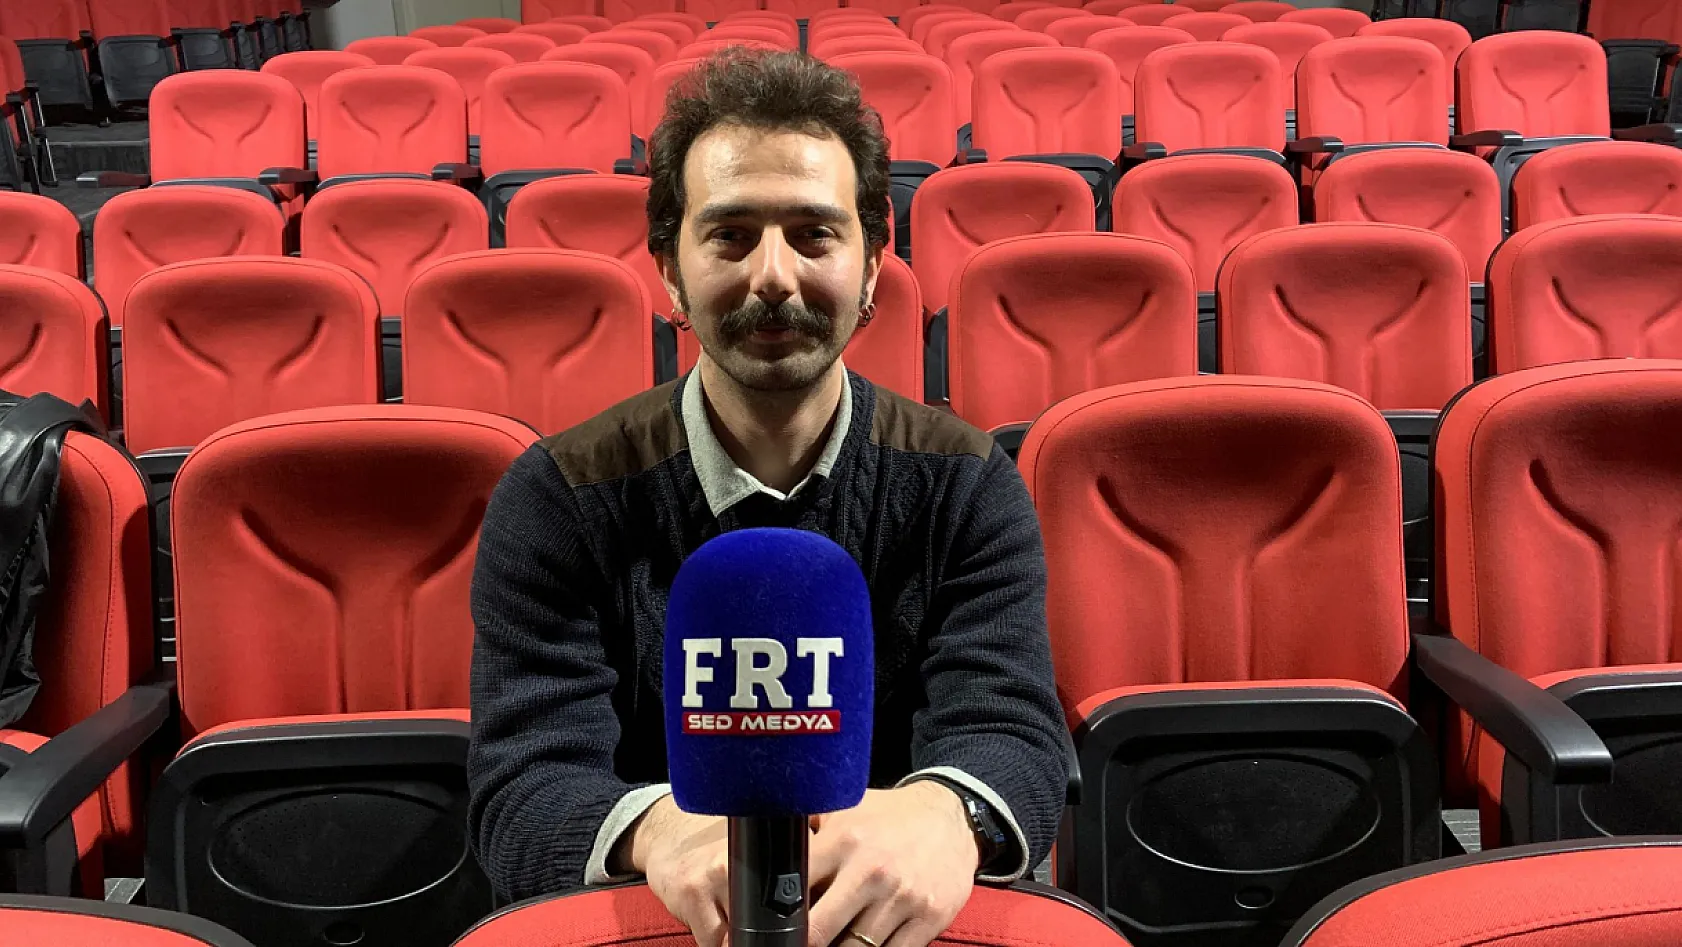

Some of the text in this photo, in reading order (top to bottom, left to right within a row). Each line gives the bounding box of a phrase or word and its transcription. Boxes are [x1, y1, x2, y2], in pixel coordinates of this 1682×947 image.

[682, 637, 844, 708] FRT
[688, 714, 834, 730] SED MEDYA
